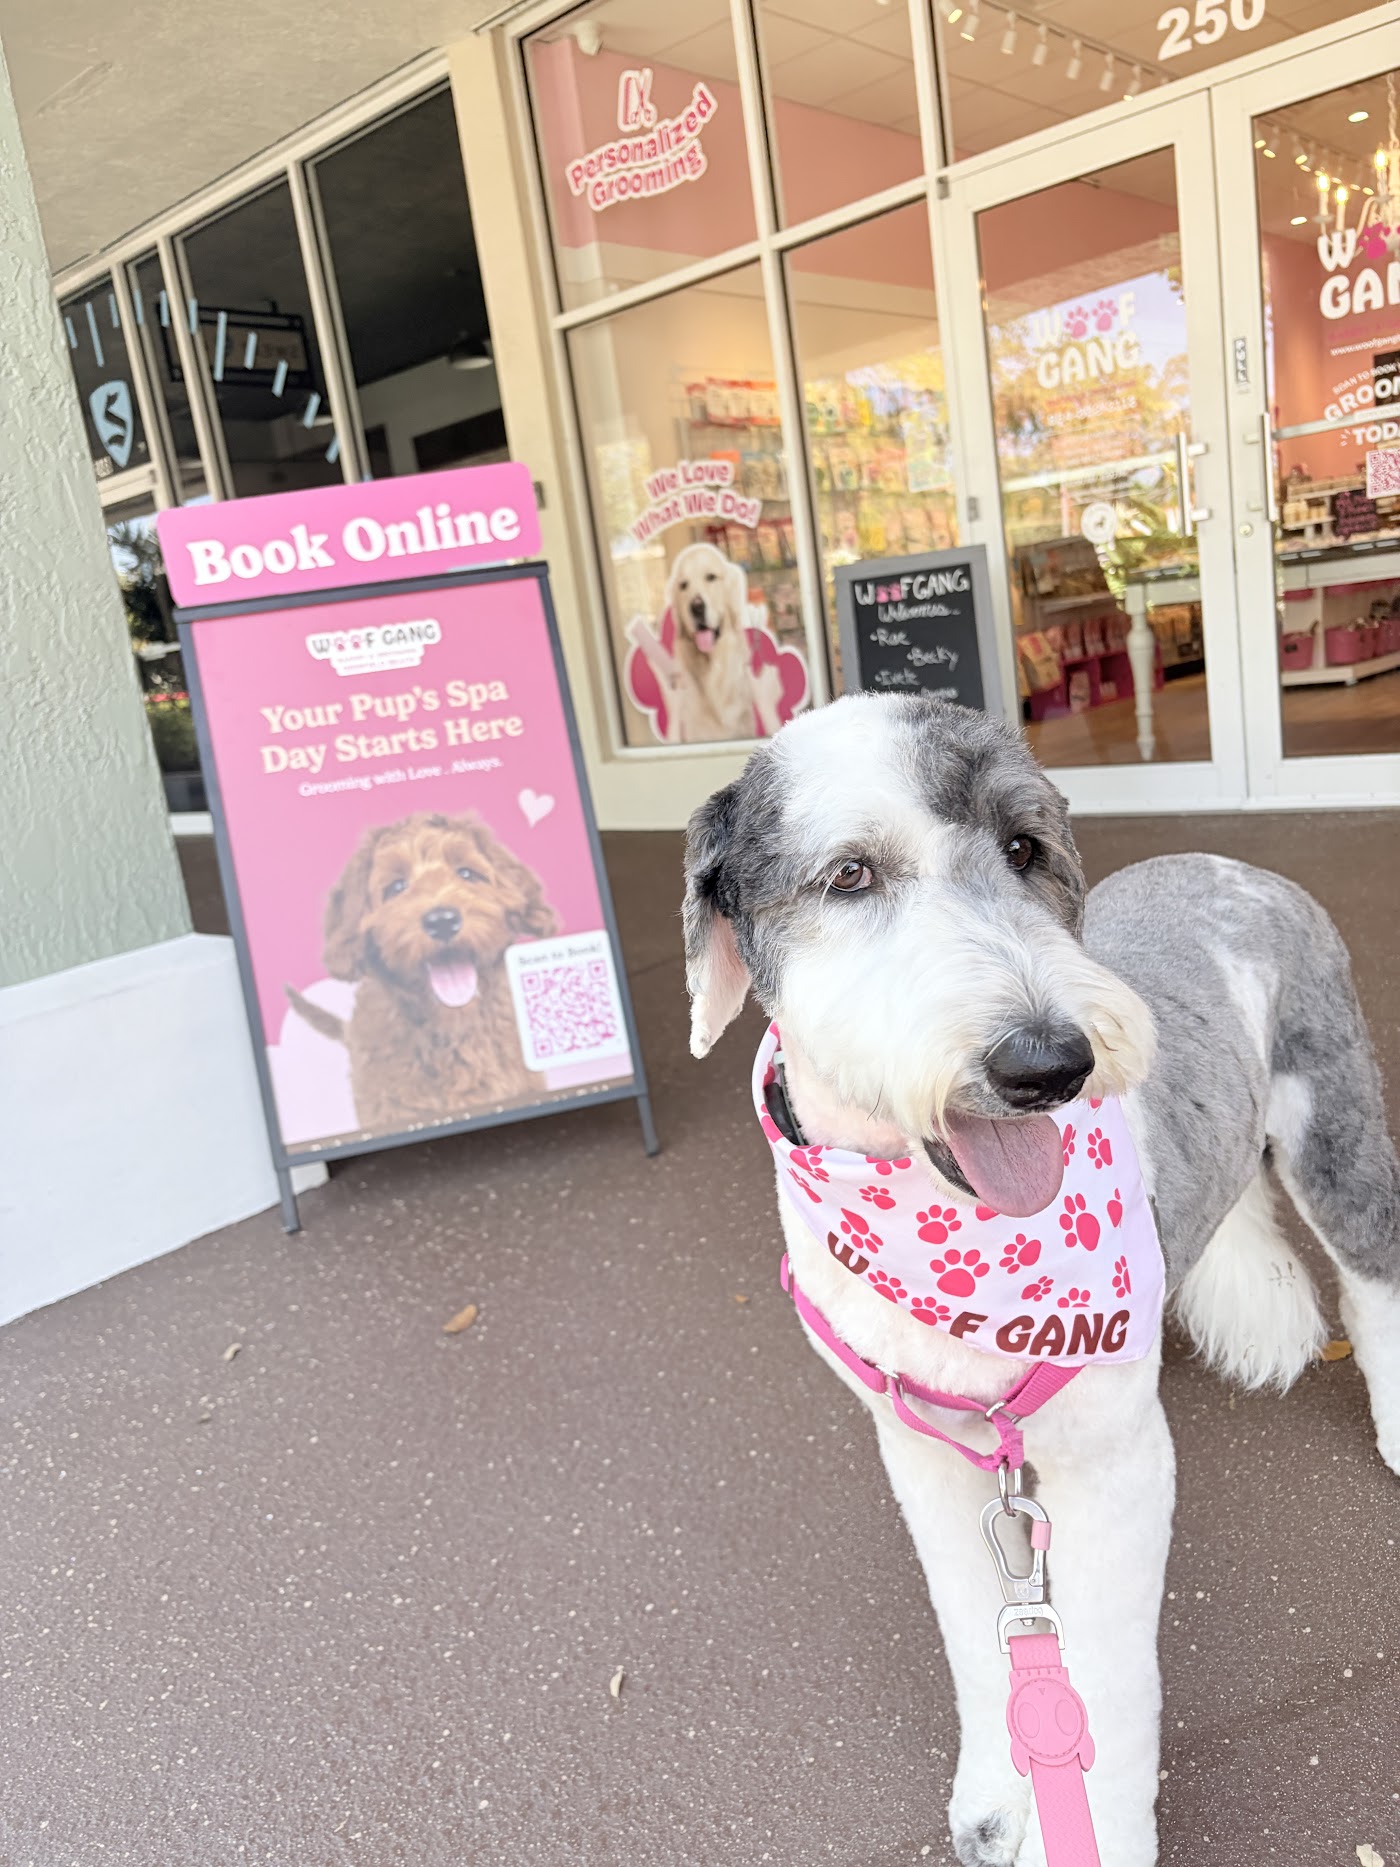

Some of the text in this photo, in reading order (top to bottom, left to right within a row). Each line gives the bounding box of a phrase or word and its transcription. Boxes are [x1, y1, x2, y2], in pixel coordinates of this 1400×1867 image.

[1157, 0, 1266, 60] 250
[570, 89, 714, 189] Personalized
[591, 145, 703, 206] Grooming
[1037, 336, 1140, 389] GANG
[1352, 421, 1400, 446] TOD
[648, 463, 730, 498] We Love
[632, 492, 759, 541] What We Do!
[186, 503, 521, 585] Book Online
[382, 624, 437, 646] GANG
[260, 679, 510, 734] Your Pup's Spa
[260, 715, 524, 774] Day Starts Here
[298, 776, 373, 797] Grooming
[373, 768, 407, 785] with
[408, 765, 443, 781] Love
[995, 1309, 1130, 1356] GANG
